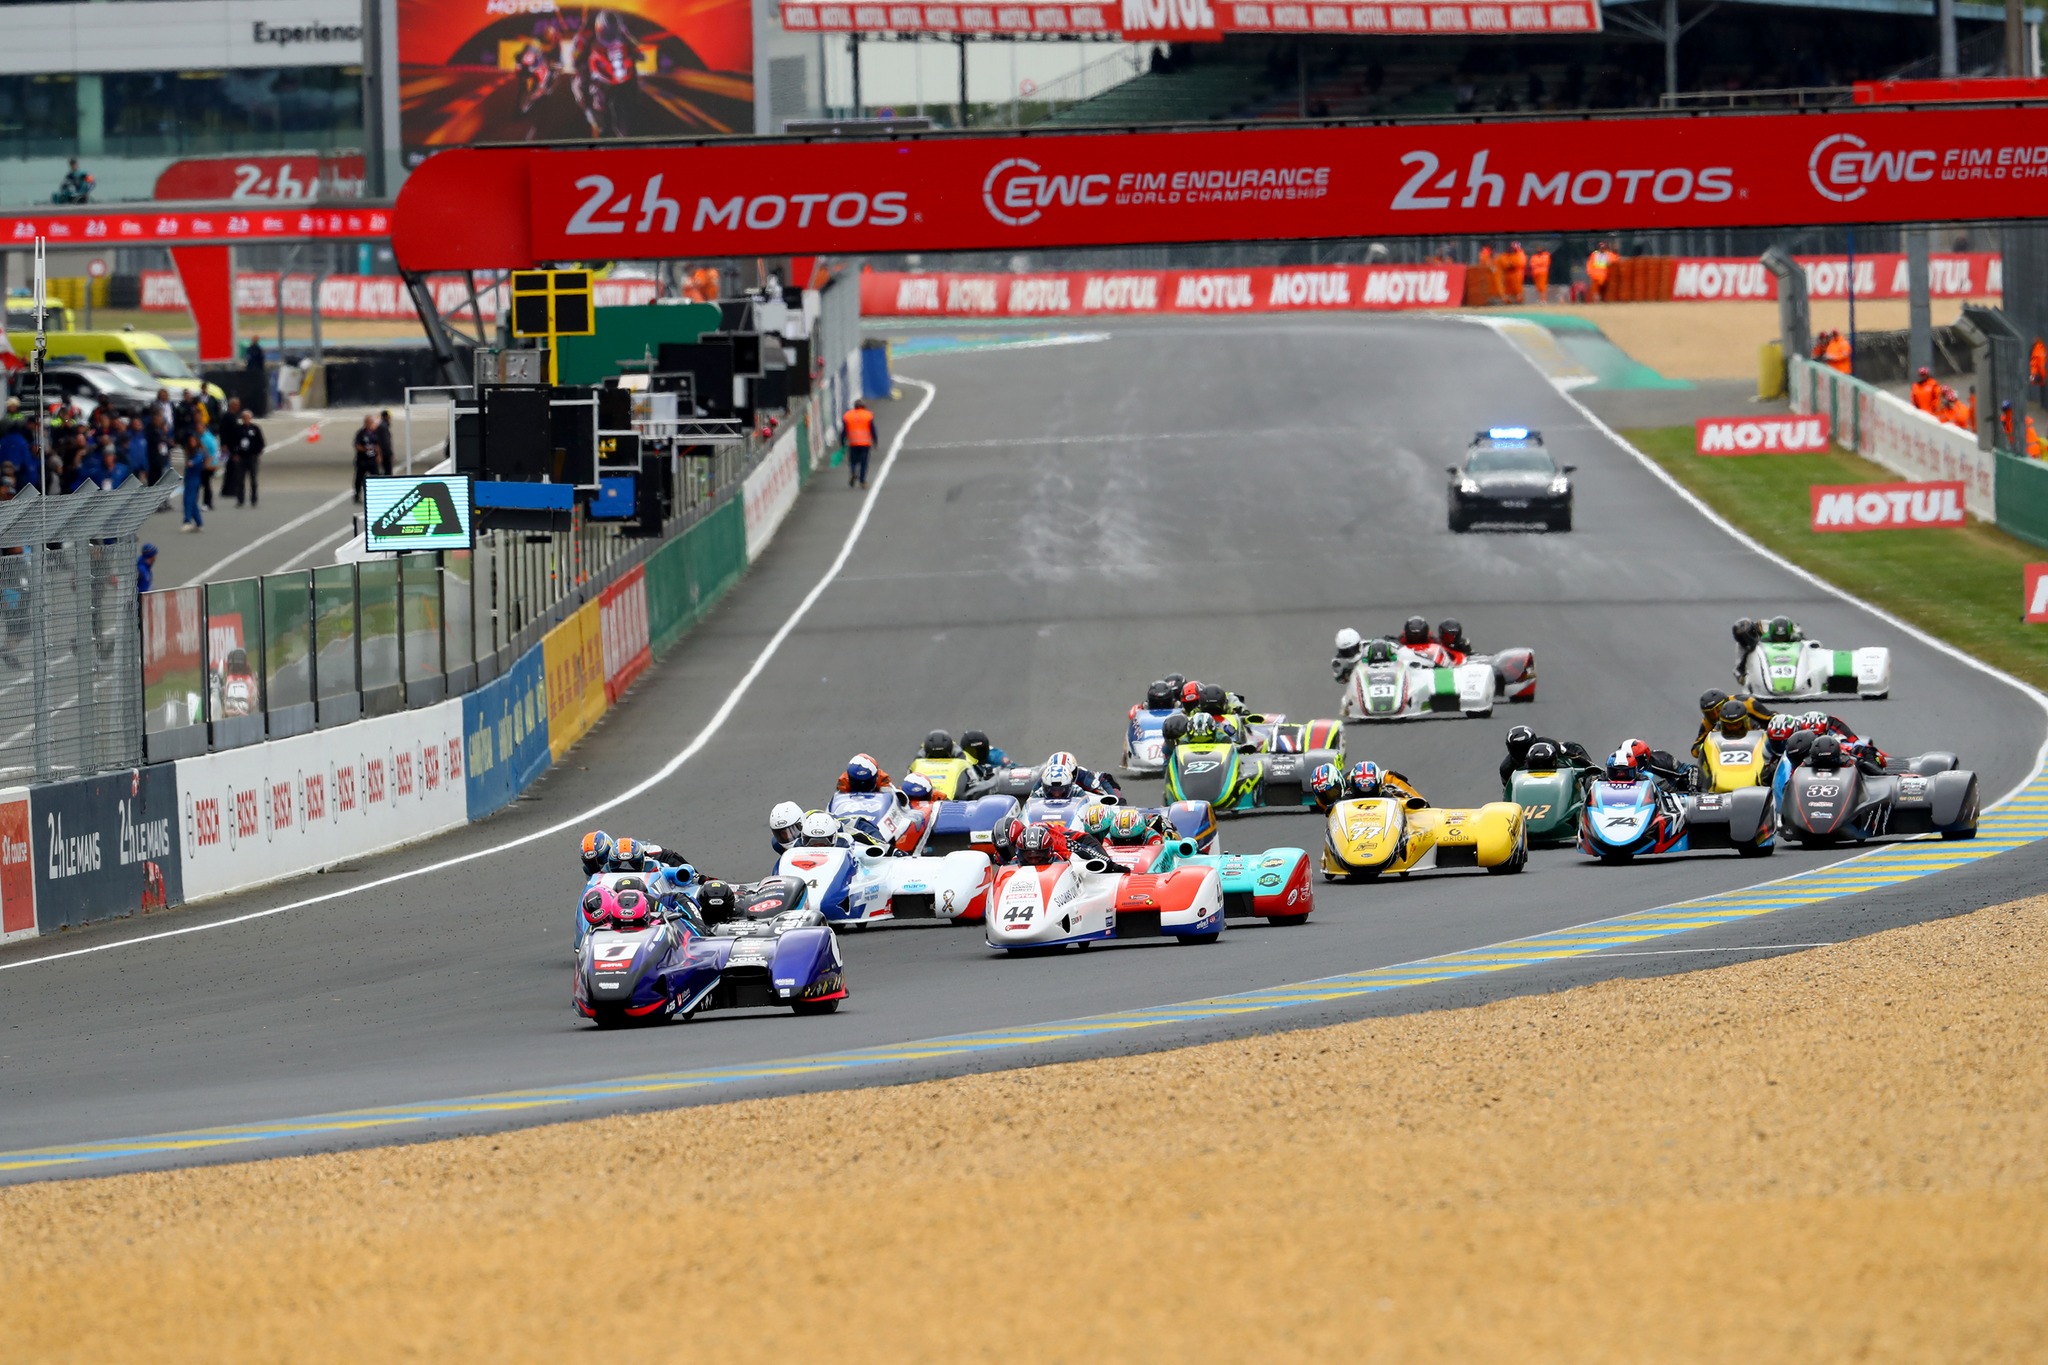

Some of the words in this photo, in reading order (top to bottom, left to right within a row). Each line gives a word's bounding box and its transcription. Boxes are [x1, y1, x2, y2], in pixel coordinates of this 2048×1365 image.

[252, 18, 363, 48] Experienc
[1831, 150, 1937, 184] EWC
[1941, 166, 2005, 181] WORLD
[1943, 148, 1993, 167] FIM
[1003, 173, 1110, 207] EWC
[1118, 172, 1167, 191] FIM
[1171, 167, 1331, 189] ENDURANCE
[1390, 149, 1505, 210] 24h
[1517, 167, 1734, 207] MOTOS
[565, 174, 681, 235] 24h
[692, 192, 908, 232] MOTOS
[1115, 190, 1179, 205] WORLD
[1184, 187, 1328, 203] CHAMPIONSHIP
[1082, 276, 1158, 309] MOTUL
[1175, 275, 1254, 308] MOTUL
[1269, 273, 1350, 305] MOTUL
[1363, 271, 1450, 303] MOTUL
[1675, 262, 1769, 297] MOTUL
[1701, 420, 1826, 451] MOTUL
[1814, 490, 1966, 526] MOTUL
[1722, 752, 1750, 763] 22
[196, 798, 221, 846] BOSCH
[236, 789, 259, 838] BOSCH
[272, 781, 293, 830] BOSCH
[305, 774, 325, 821] BOSCH
[337, 765, 356, 812] BOSCH
[1806, 784, 1840, 798] 33
[48, 811, 66, 879] 24h
[65, 837, 77, 876] LE
[77, 831, 101, 875] MANS
[119, 798, 136, 865] 24h
[135, 823, 147, 861] LE
[147, 818, 170, 859] MANS
[1350, 826, 1385, 842] 77
[1003, 905, 1035, 922] 44
[605, 945, 628, 958] 1
